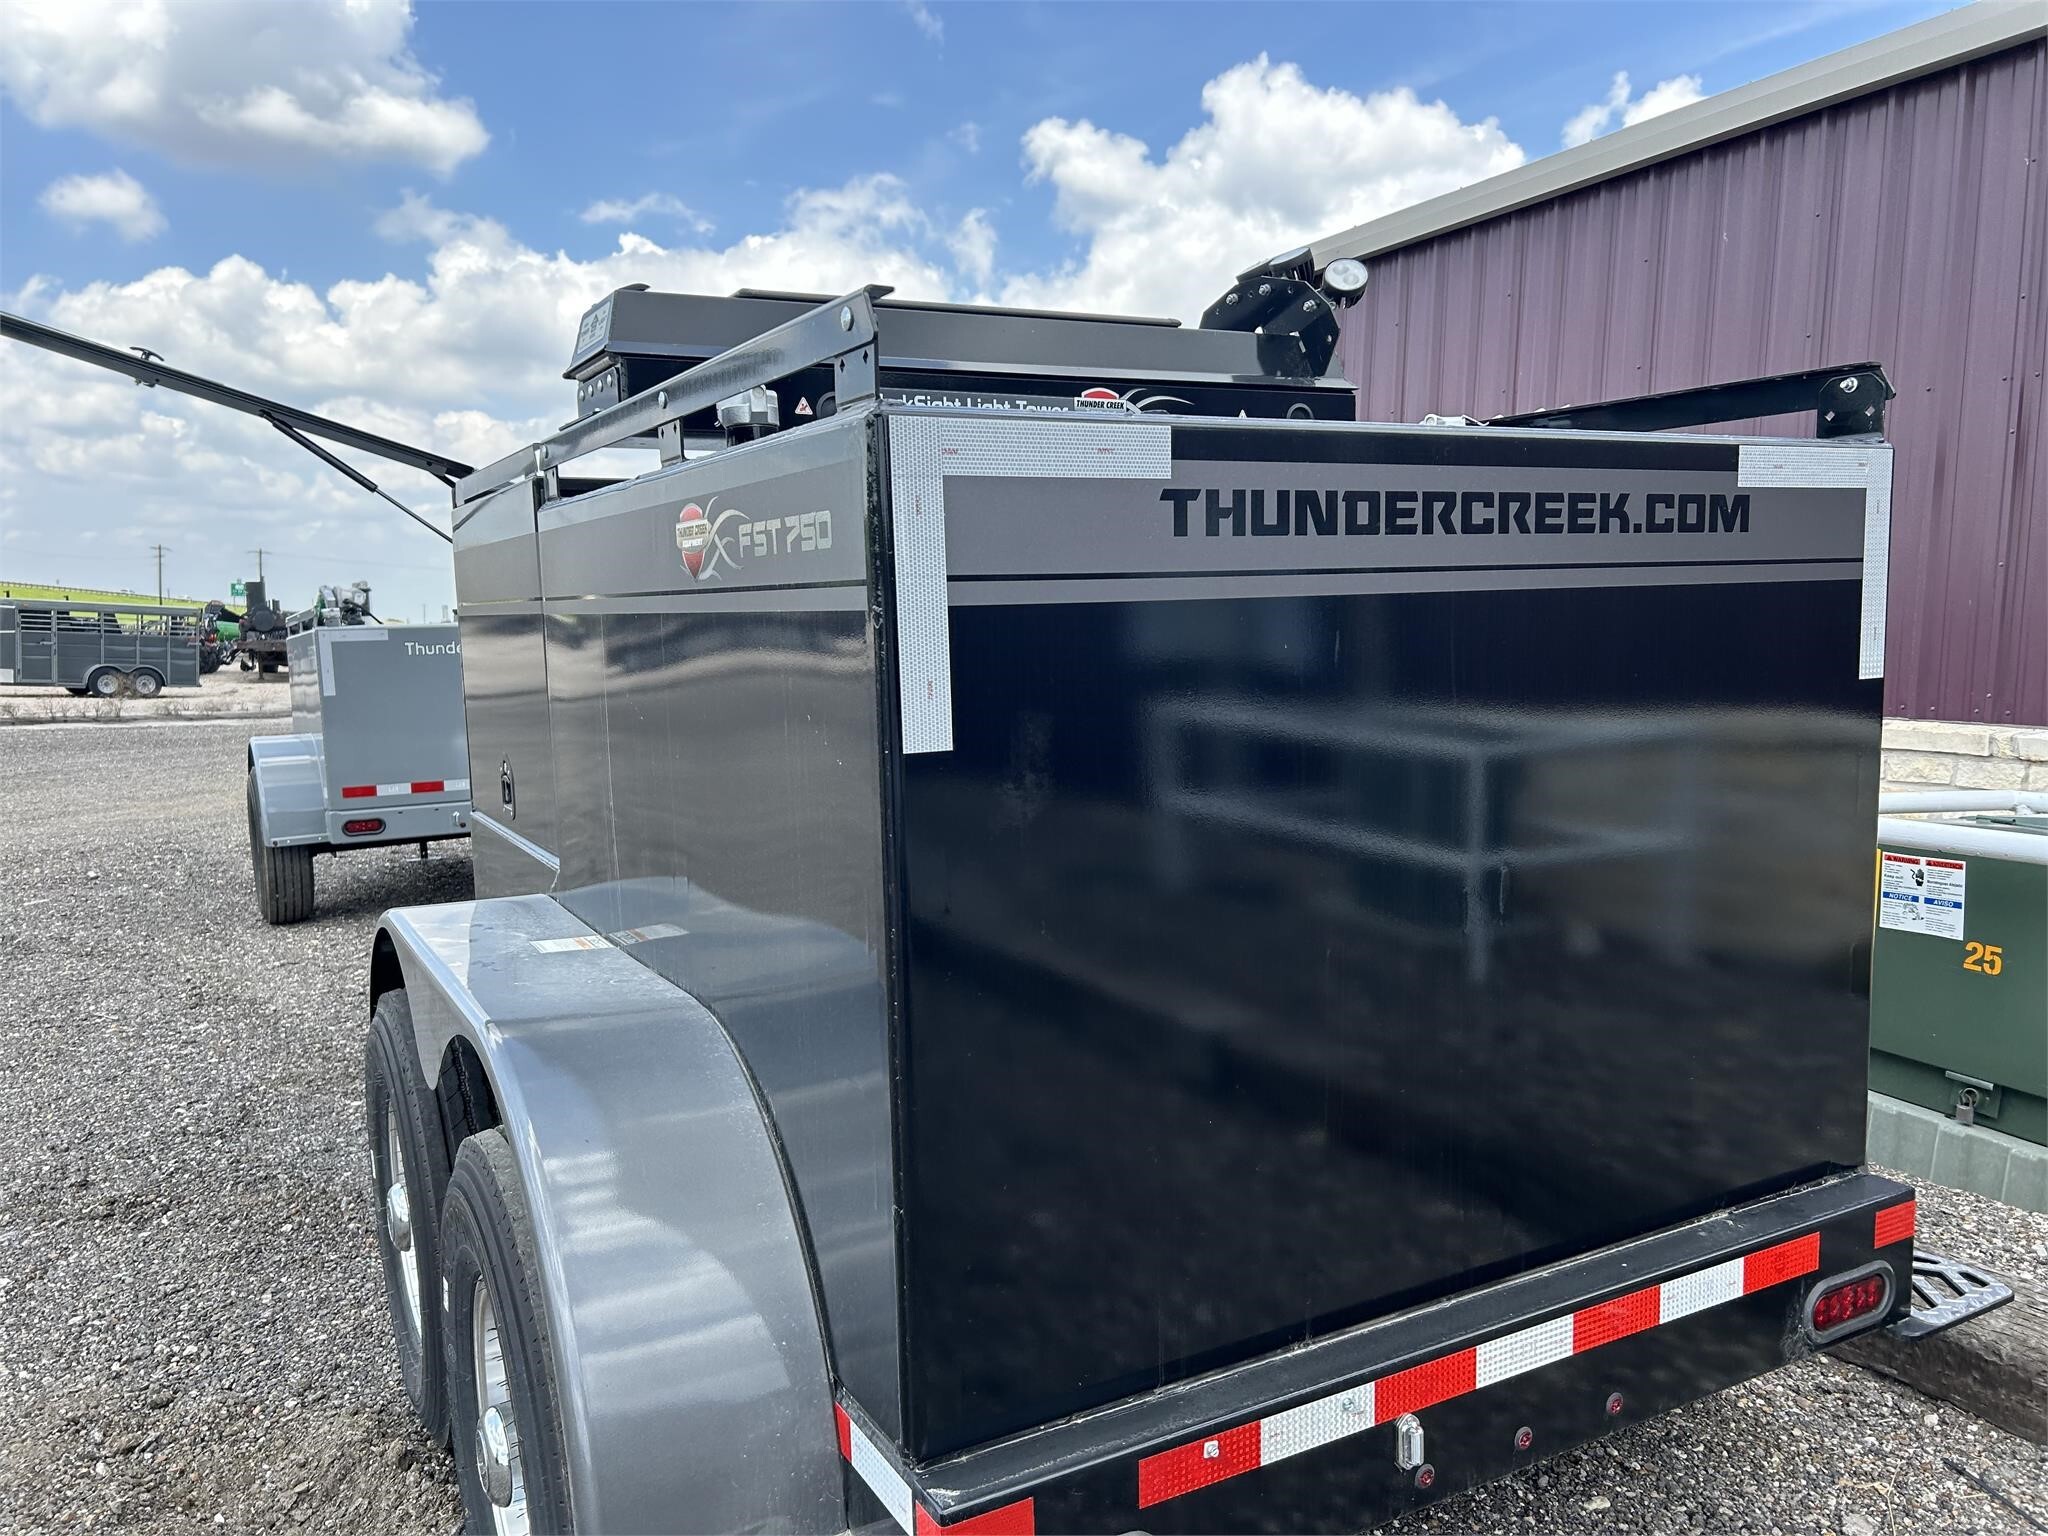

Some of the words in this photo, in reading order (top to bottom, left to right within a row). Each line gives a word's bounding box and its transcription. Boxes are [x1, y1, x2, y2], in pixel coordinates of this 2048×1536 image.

[1076, 399, 1105, 409] THUNDER
[1106, 401, 1125, 410] CREEK
[1160, 488, 1750, 537] THUNDERCREEK.COM
[738, 518, 782, 559] FST
[784, 510, 832, 554] 750
[1888, 892, 1913, 903] NOTICE
[1933, 899, 1954, 908] AVISO
[1963, 941, 2002, 975] 25
